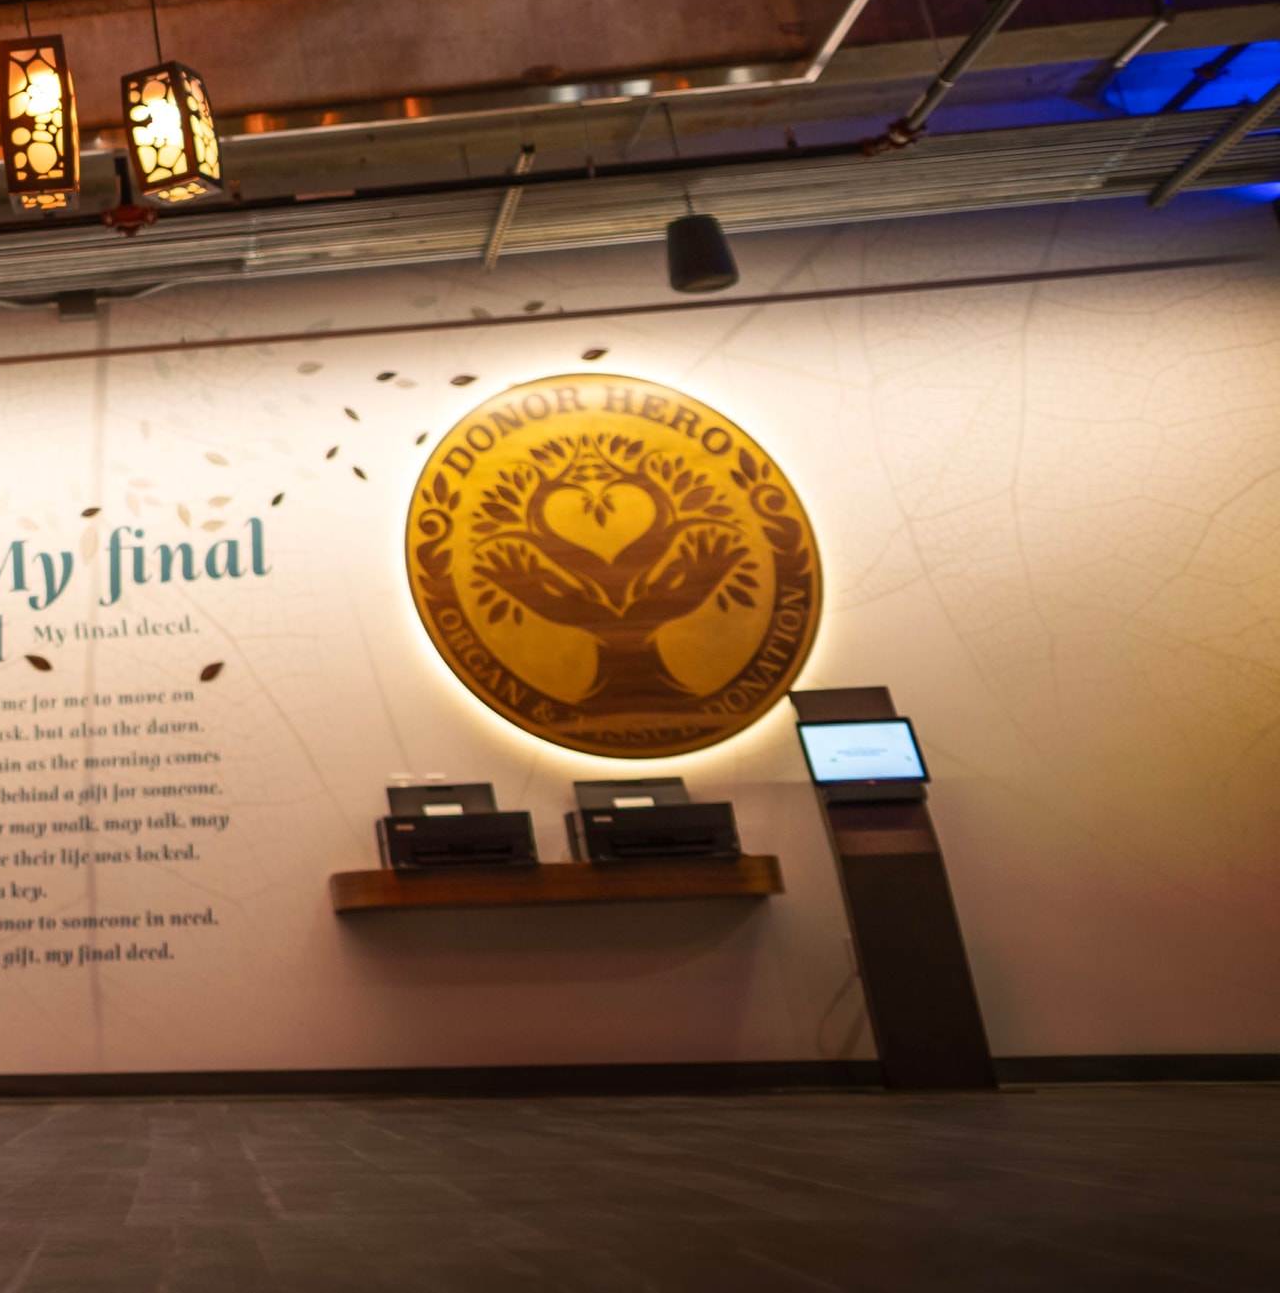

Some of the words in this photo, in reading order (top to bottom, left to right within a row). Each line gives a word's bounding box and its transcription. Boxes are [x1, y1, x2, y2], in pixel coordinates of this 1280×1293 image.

[442, 386, 589, 478] DONOR
[602, 384, 734, 456] HERO
[99, 516, 273, 607] final
[33, 623, 72, 647] My
[75, 618, 128, 641] final
[137, 614, 199, 637] deed.
[439, 608, 528, 706] ORGAN
[532, 701, 555, 722] &
[704, 584, 808, 717] DONATION
[32, 694, 57, 713] for
[64, 695, 89, 707] me
[93, 693, 112, 706] to
[118, 691, 166, 705] move
[172, 689, 194, 702] on
[34, 723, 63, 740] but
[69, 721, 108, 739] also
[113, 720, 141, 736] the
[26, 760, 47, 772] as
[51, 753, 78, 770] the
[84, 751, 161, 772] morning
[165, 751, 221, 766] comes
[0, 785, 59, 804] behind
[63, 789, 74, 801] a
[78, 783, 108, 806] gift
[113, 782, 137, 803] for
[9, 821, 47, 839] may
[104, 817, 142, 834] may
[190, 814, 229, 832] may
[13, 849, 55, 867] their
[61, 847, 89, 869] life
[94, 850, 132, 863] was
[39, 915, 57, 931] to
[61, 914, 141, 930] someone
[145, 910, 164, 927] in
[45, 948, 73, 968] my
[78, 942, 121, 967] final
